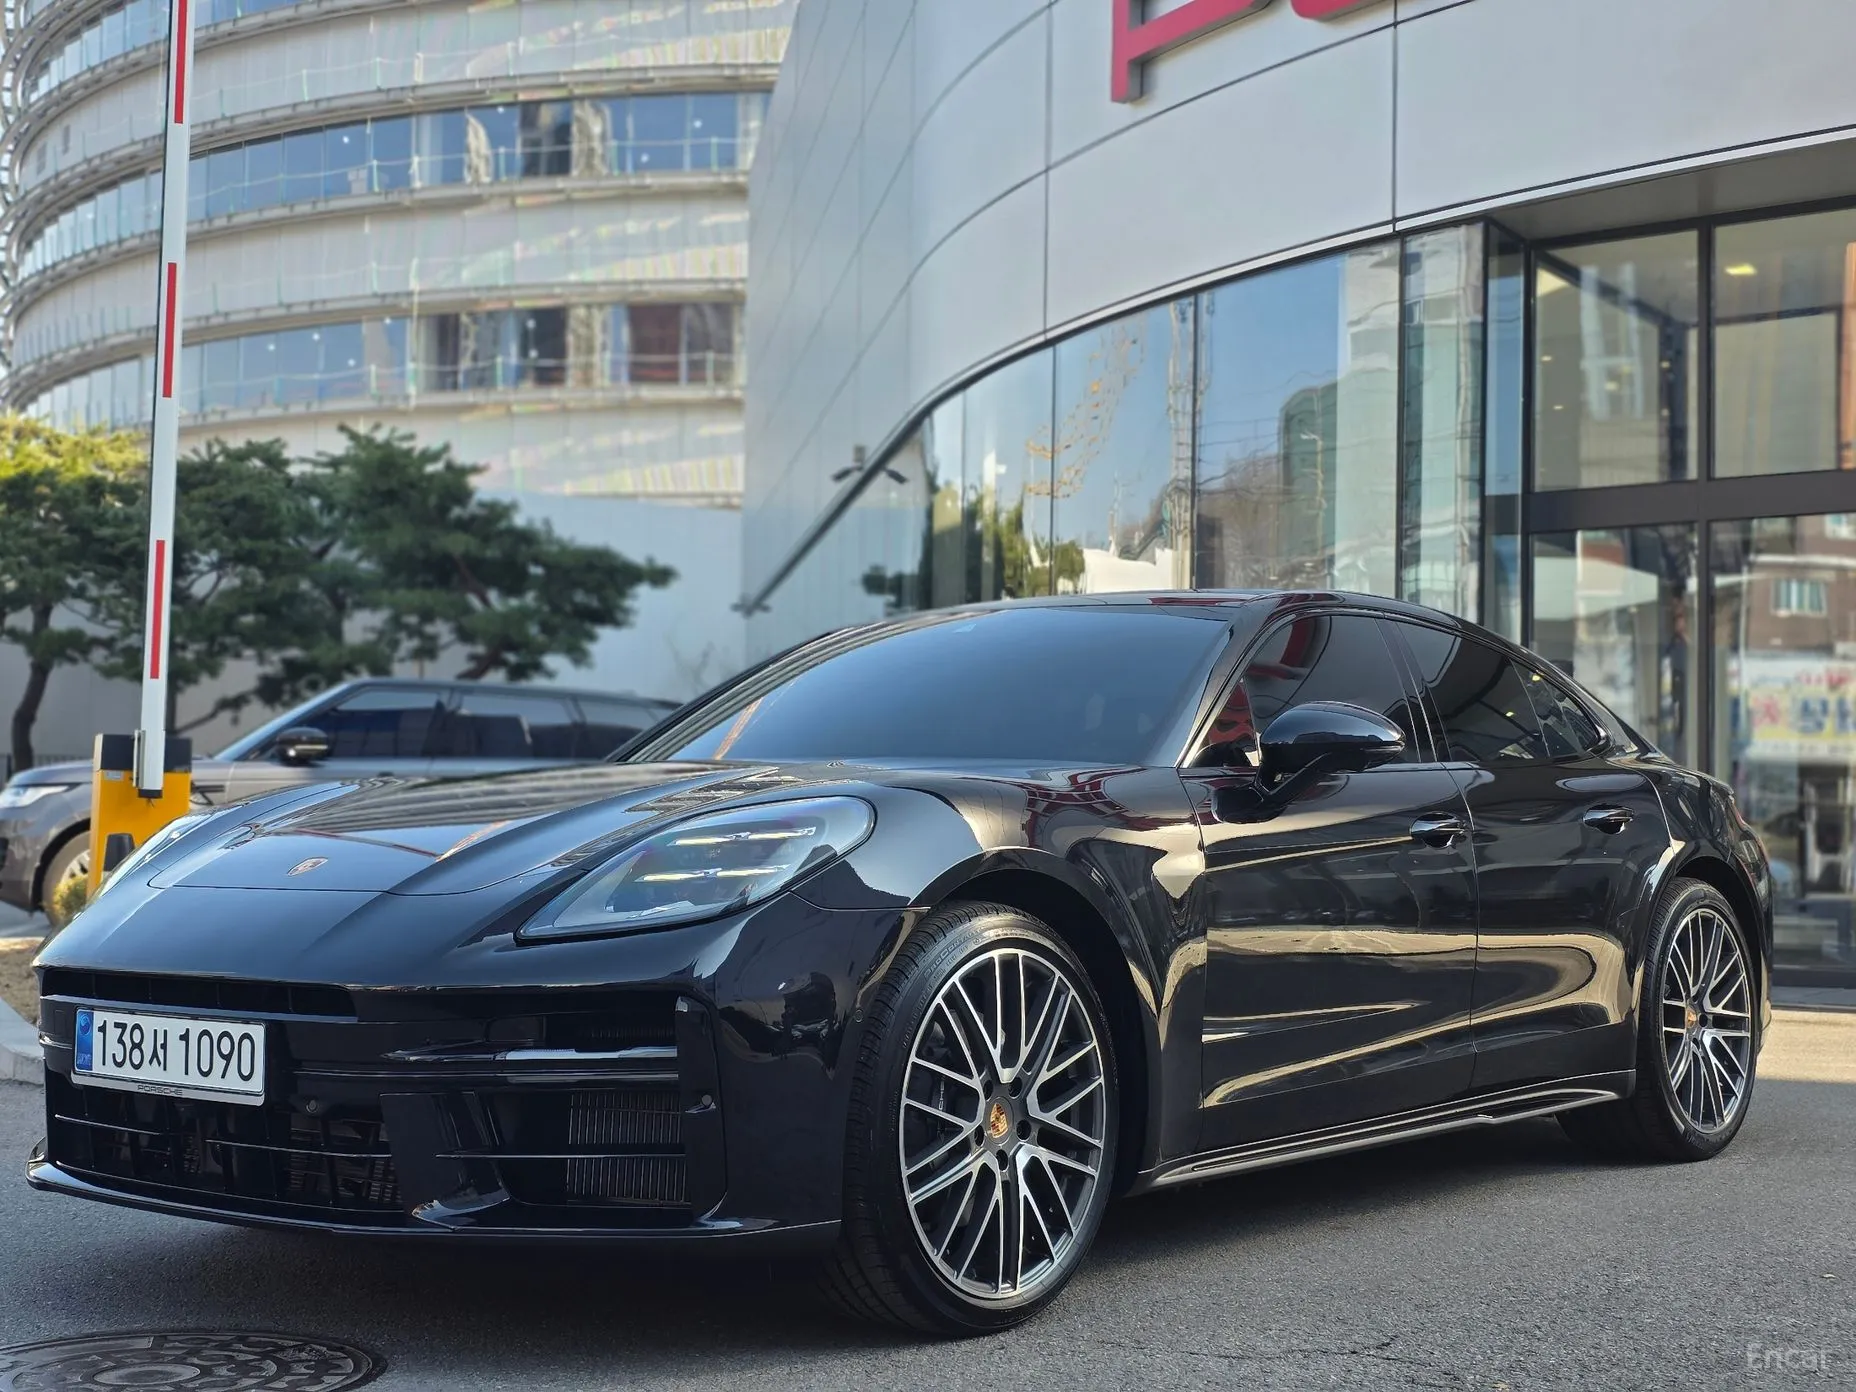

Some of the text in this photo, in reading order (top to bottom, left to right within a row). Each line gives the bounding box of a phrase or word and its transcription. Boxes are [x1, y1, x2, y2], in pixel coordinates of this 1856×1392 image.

[97, 1019, 256, 1082] 138서 1090
[137, 1084, 183, 1096] PORSCHE
